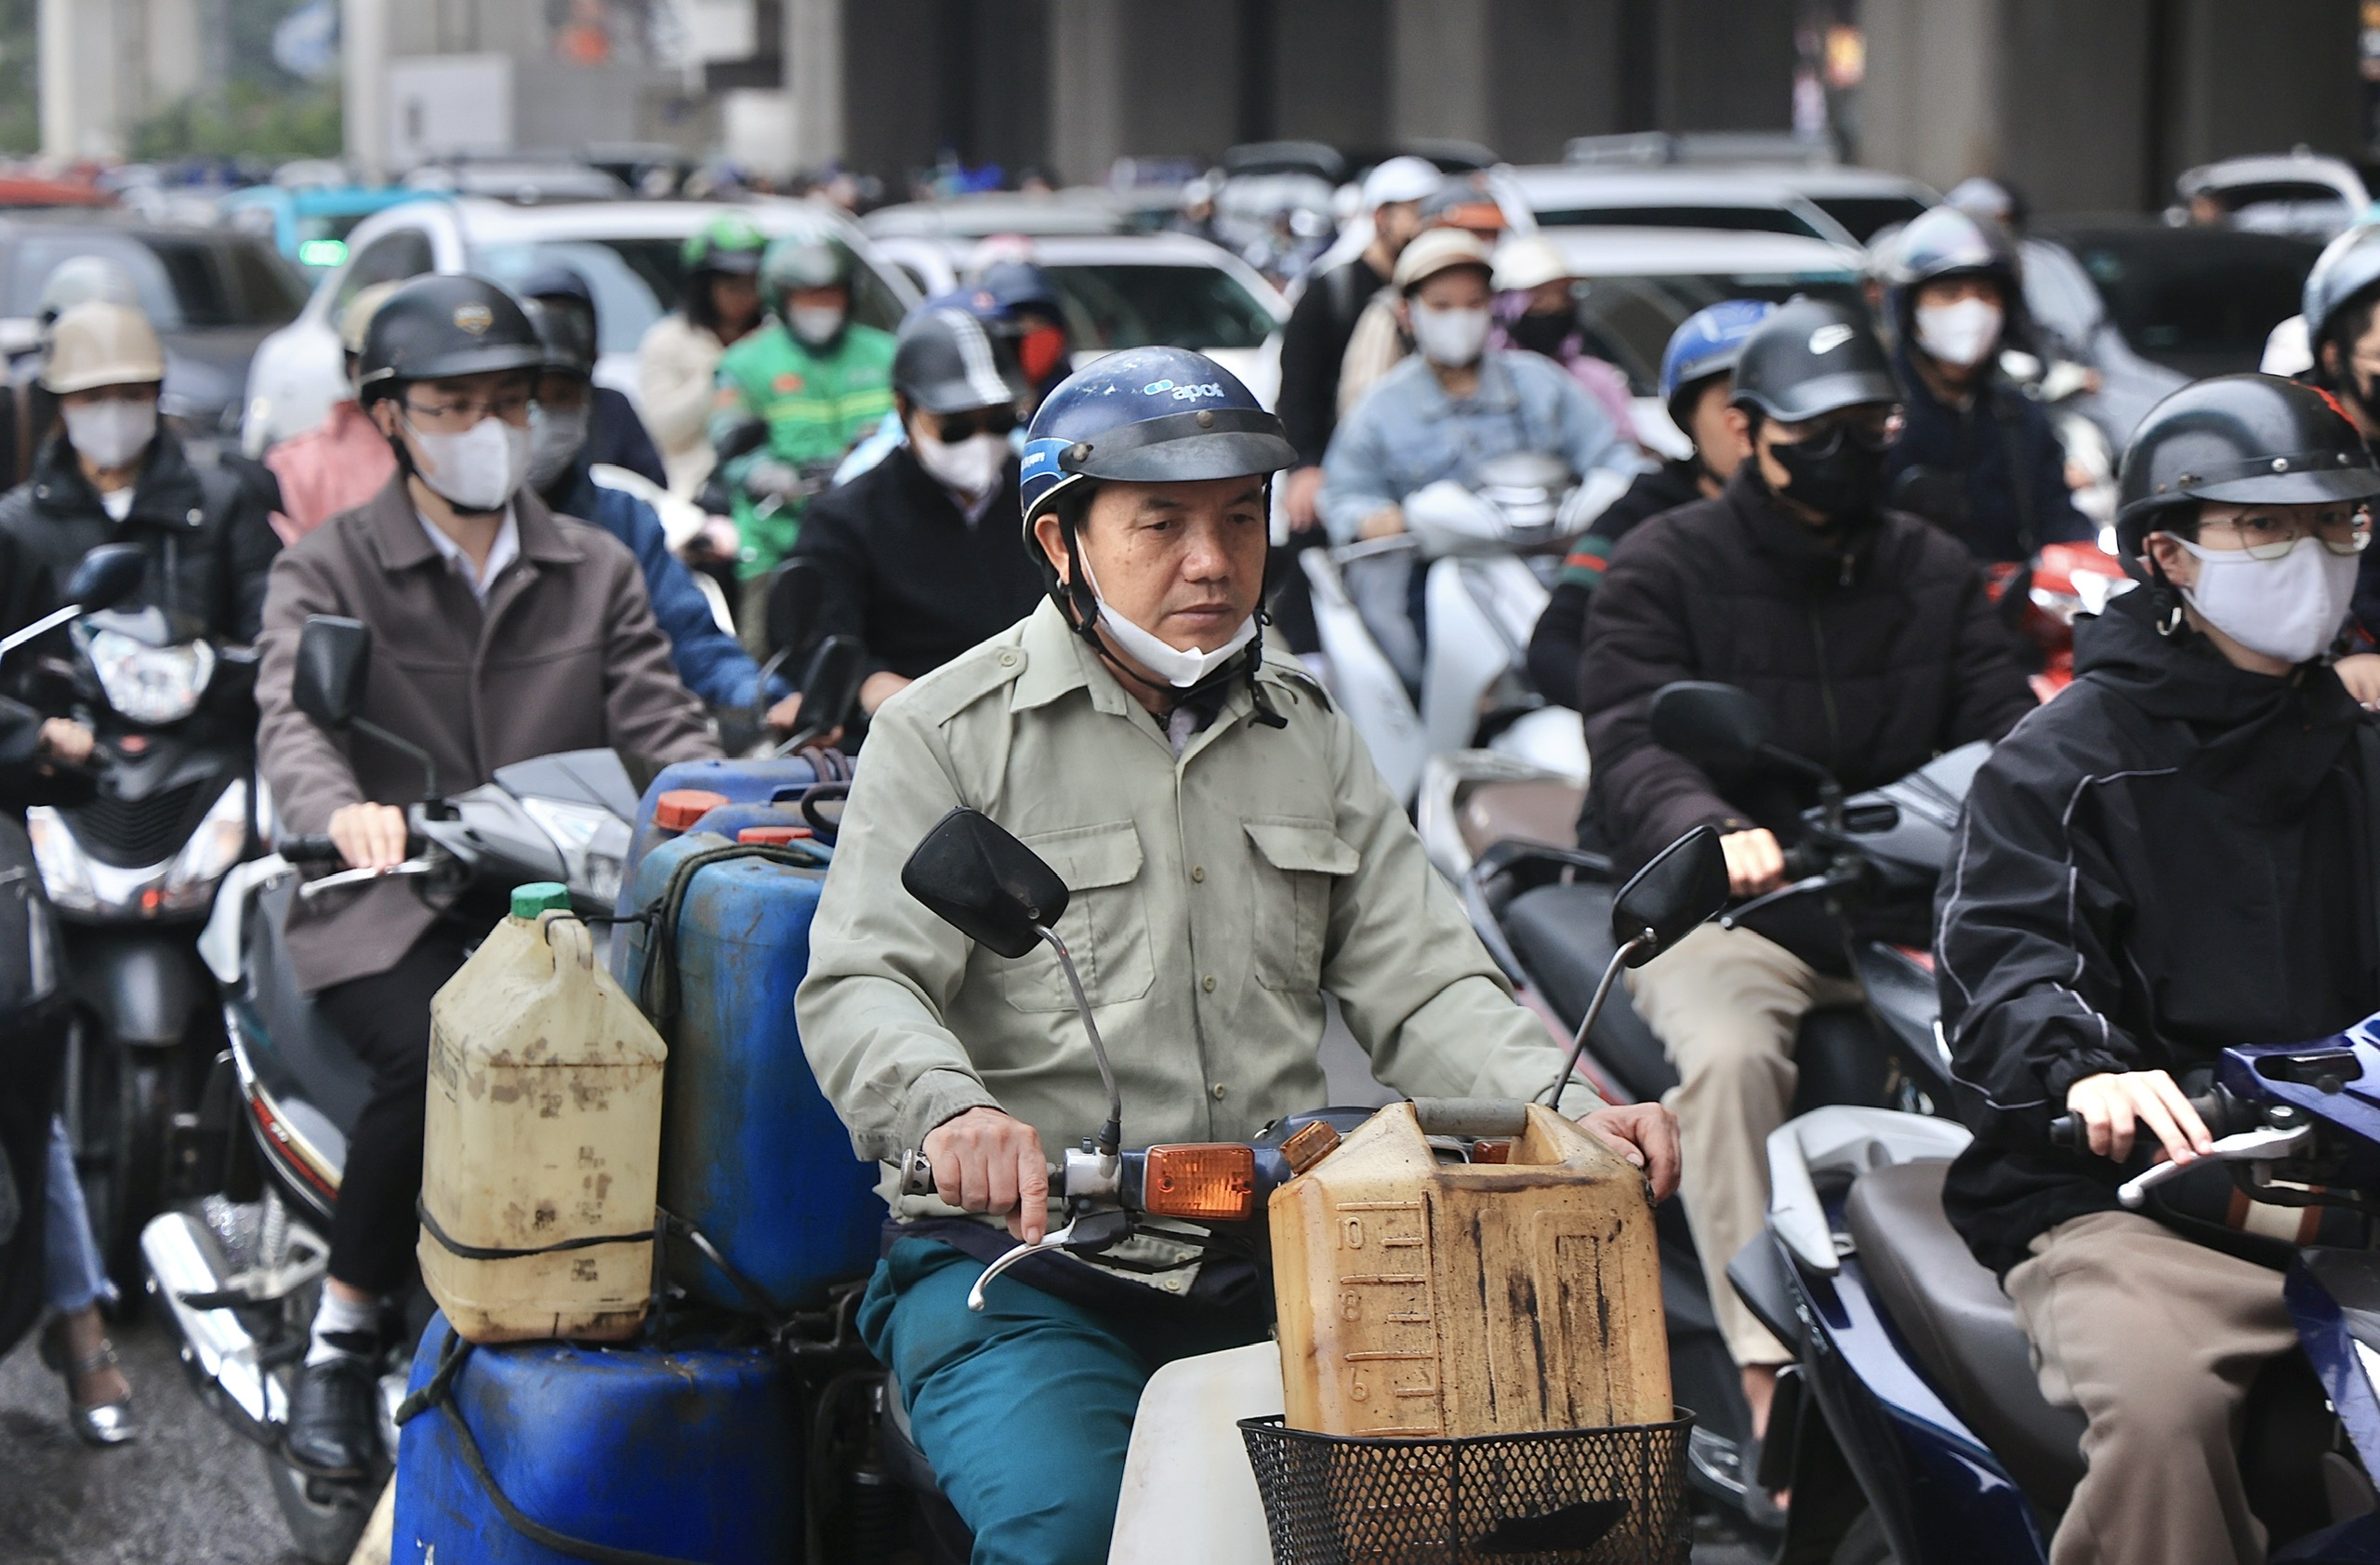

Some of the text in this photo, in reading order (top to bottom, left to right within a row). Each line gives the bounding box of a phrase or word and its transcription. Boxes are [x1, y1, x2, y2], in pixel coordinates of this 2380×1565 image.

[1335, 1216, 1365, 1250] 10
[1342, 1290, 1362, 1322] 8
[1350, 1367, 1369, 1402] 6
